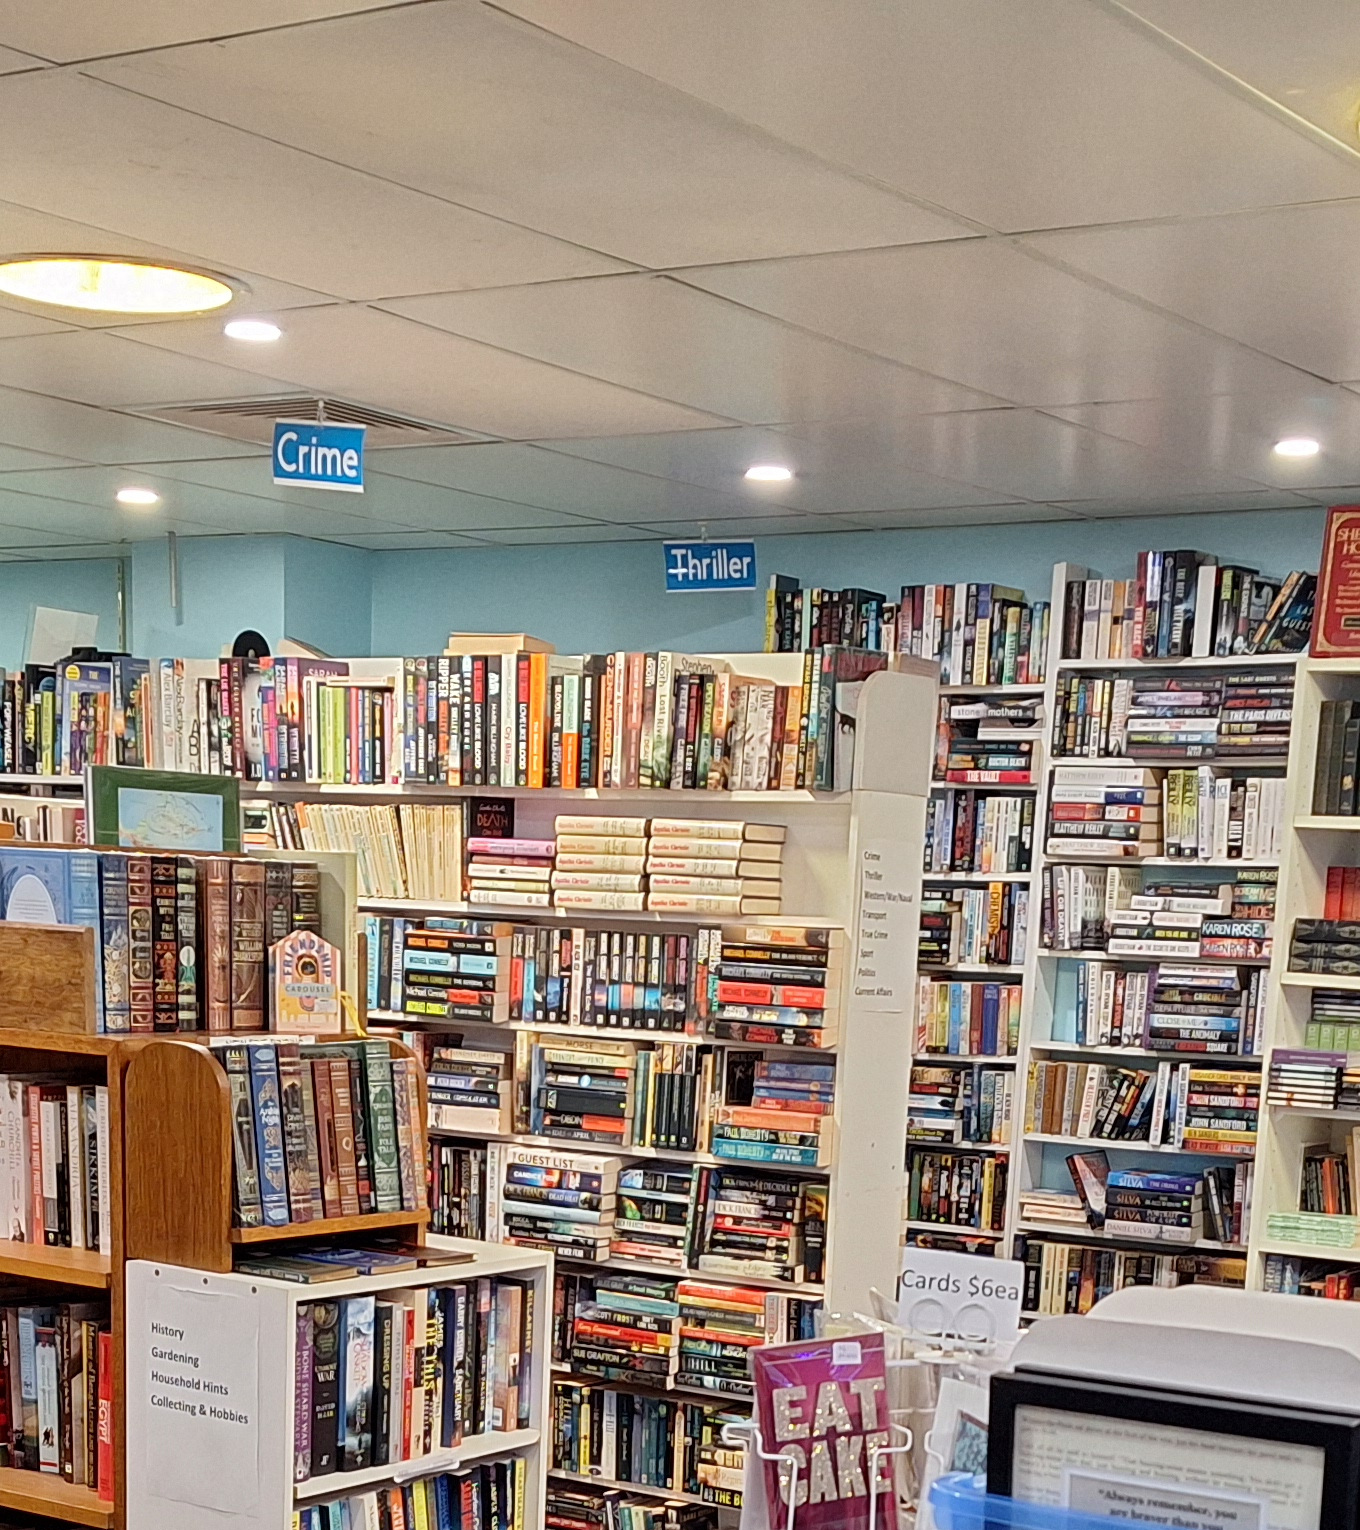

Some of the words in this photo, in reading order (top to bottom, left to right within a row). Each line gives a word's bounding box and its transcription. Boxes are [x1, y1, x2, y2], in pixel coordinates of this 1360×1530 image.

[277, 432, 359, 478] Crime
[668, 549, 751, 580] Thriller
[863, 850, 881, 862] Crime
[864, 871, 882, 883] Thriller
[862, 911, 887, 922] Transport
[862, 930, 873, 939] True
[874, 931, 888, 939] Crime
[1202, 922, 1230, 937] KAREN
[1232, 922, 1261, 938] ROSE
[282, 939, 333, 978] FRIENDSHIP
[860, 949, 874, 958] Sport
[858, 968, 876, 978] Politics
[285, 985, 331, 994] CAROUSEL
[854, 987, 874, 996] Current
[875, 988, 892, 997] Affairs
[518, 1153, 551, 1167] GUEST
[554, 1156, 575, 1169] LIST
[1119, 1176, 1143, 1189] SILVA
[902, 1269, 960, 1293] Cards
[968, 1274, 1019, 1300] $6ea
[151, 1323, 184, 1341] History
[151, 1346, 200, 1368] Gardening
[573, 1348, 585, 1360] SUE
[586, 1351, 621, 1364] GRAFTON
[151, 1371, 199, 1393] Household
[203, 1380, 229, 1397] Hints
[151, 1395, 196, 1417] Collecting
[199, 1404, 207, 1416] &
[209, 1405, 249, 1425] Hobbies
[772, 1377, 886, 1442] EAT
[98, 1397, 111, 1445] EGYPT
[778, 1432, 892, 1507] CAKE
